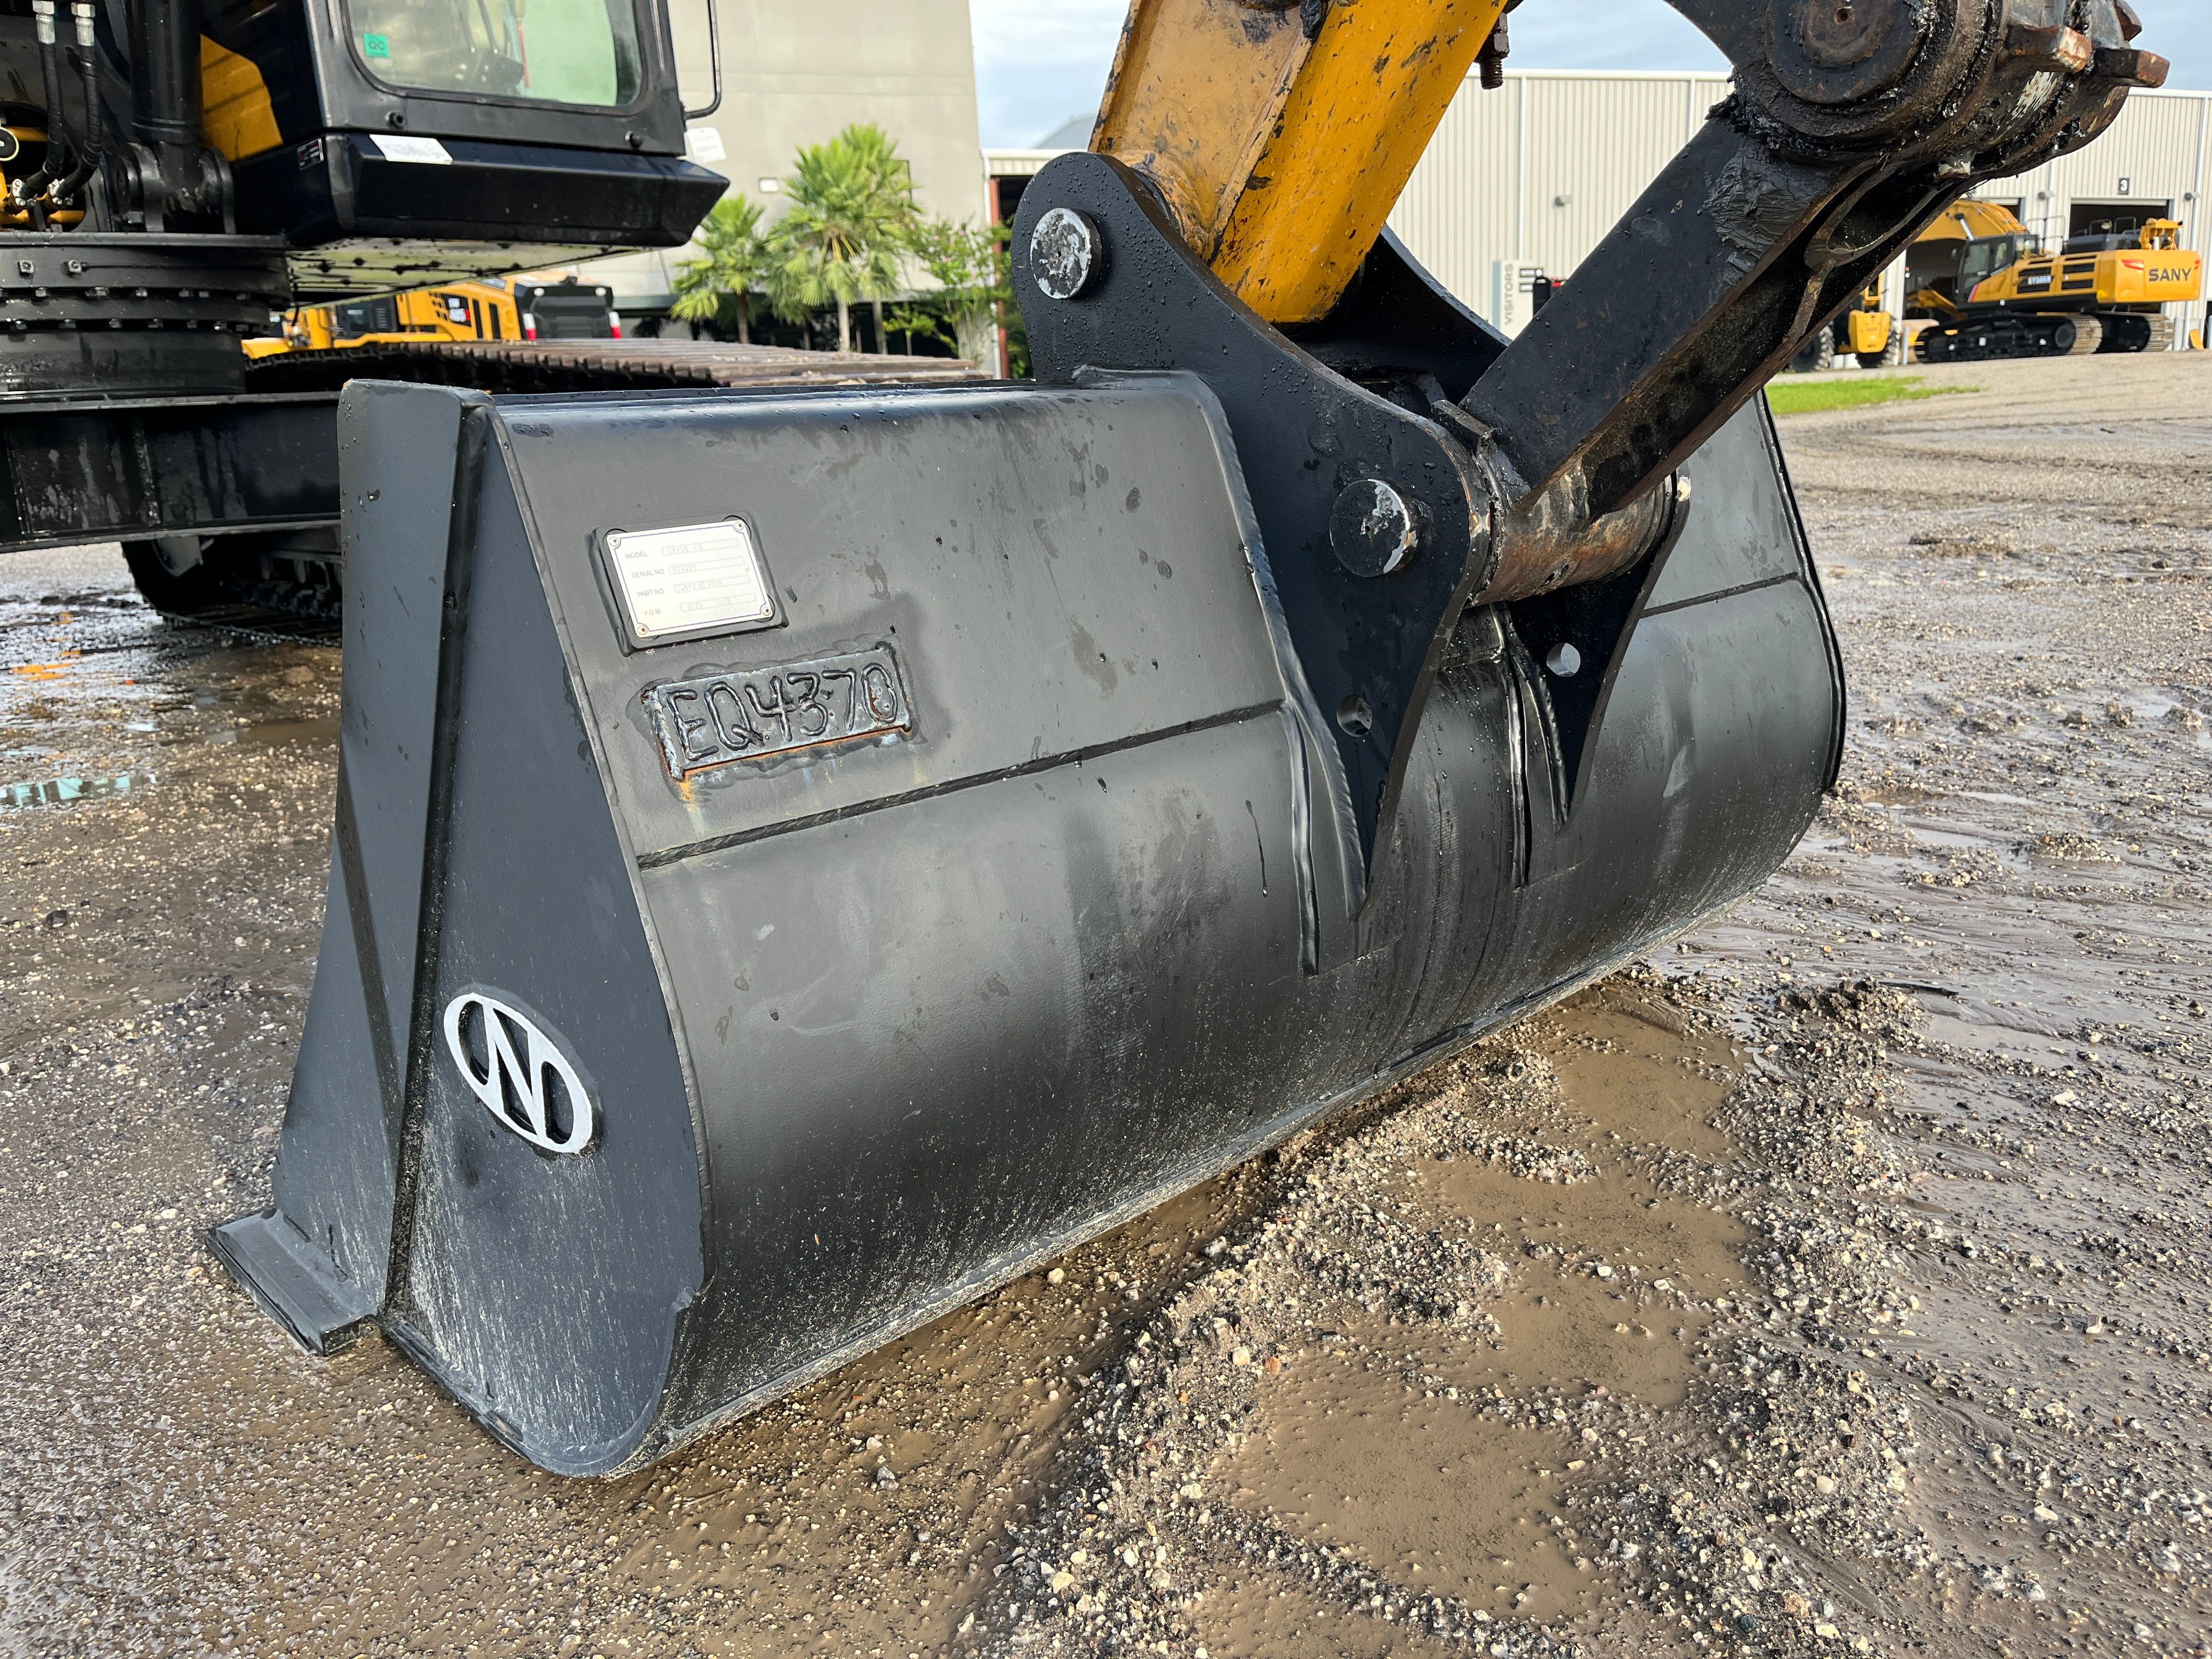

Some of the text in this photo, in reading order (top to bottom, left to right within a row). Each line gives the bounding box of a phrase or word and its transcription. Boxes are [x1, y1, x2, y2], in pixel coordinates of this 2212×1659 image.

[2120, 179, 2128, 191] 3
[2149, 268, 2192, 281] SANY
[1504, 264, 1513, 325] VISITORS
[625, 551, 648, 559] MODEL
[637, 589, 653, 597] PART
[665, 662, 899, 762] EQ4370
